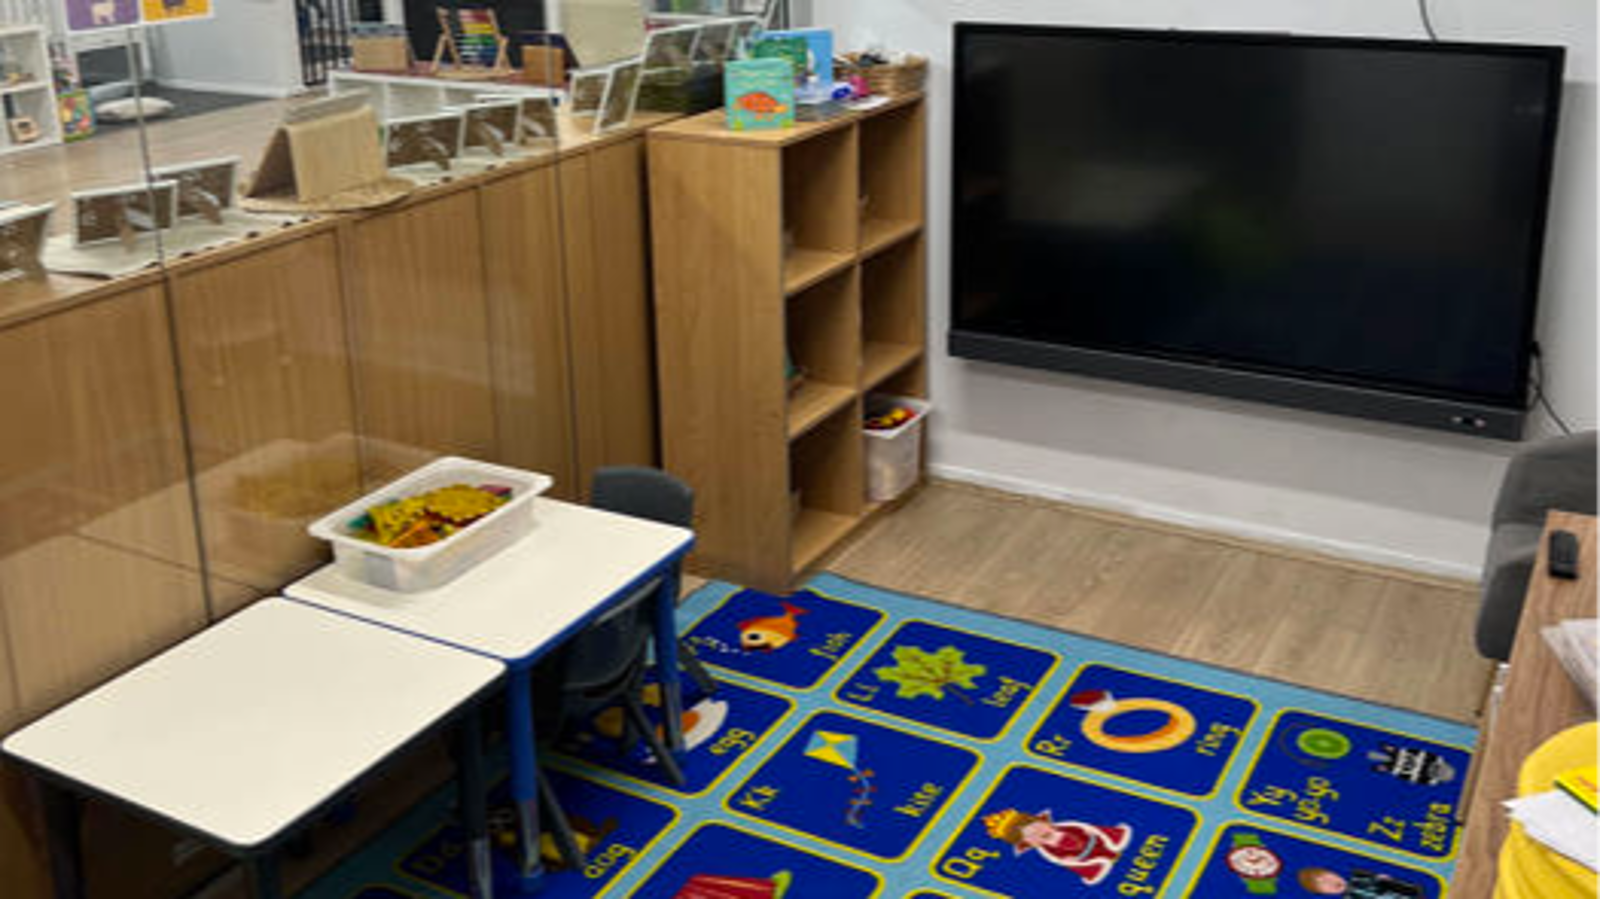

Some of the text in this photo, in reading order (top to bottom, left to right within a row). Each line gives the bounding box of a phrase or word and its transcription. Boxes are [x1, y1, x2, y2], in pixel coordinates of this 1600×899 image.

[980, 676, 1033, 708] leaf
[709, 727, 757, 755] egg
[1035, 734, 1072, 756] Rr
[1195, 722, 1245, 756] ring
[739, 784, 780, 811] Kk
[893, 782, 943, 817] kite
[1247, 785, 1299, 806] Yy
[1366, 816, 1406, 841] Zz
[1411, 803, 1453, 852] zebra
[942, 847, 1000, 878] Qq
[1117, 834, 1170, 896] queen
